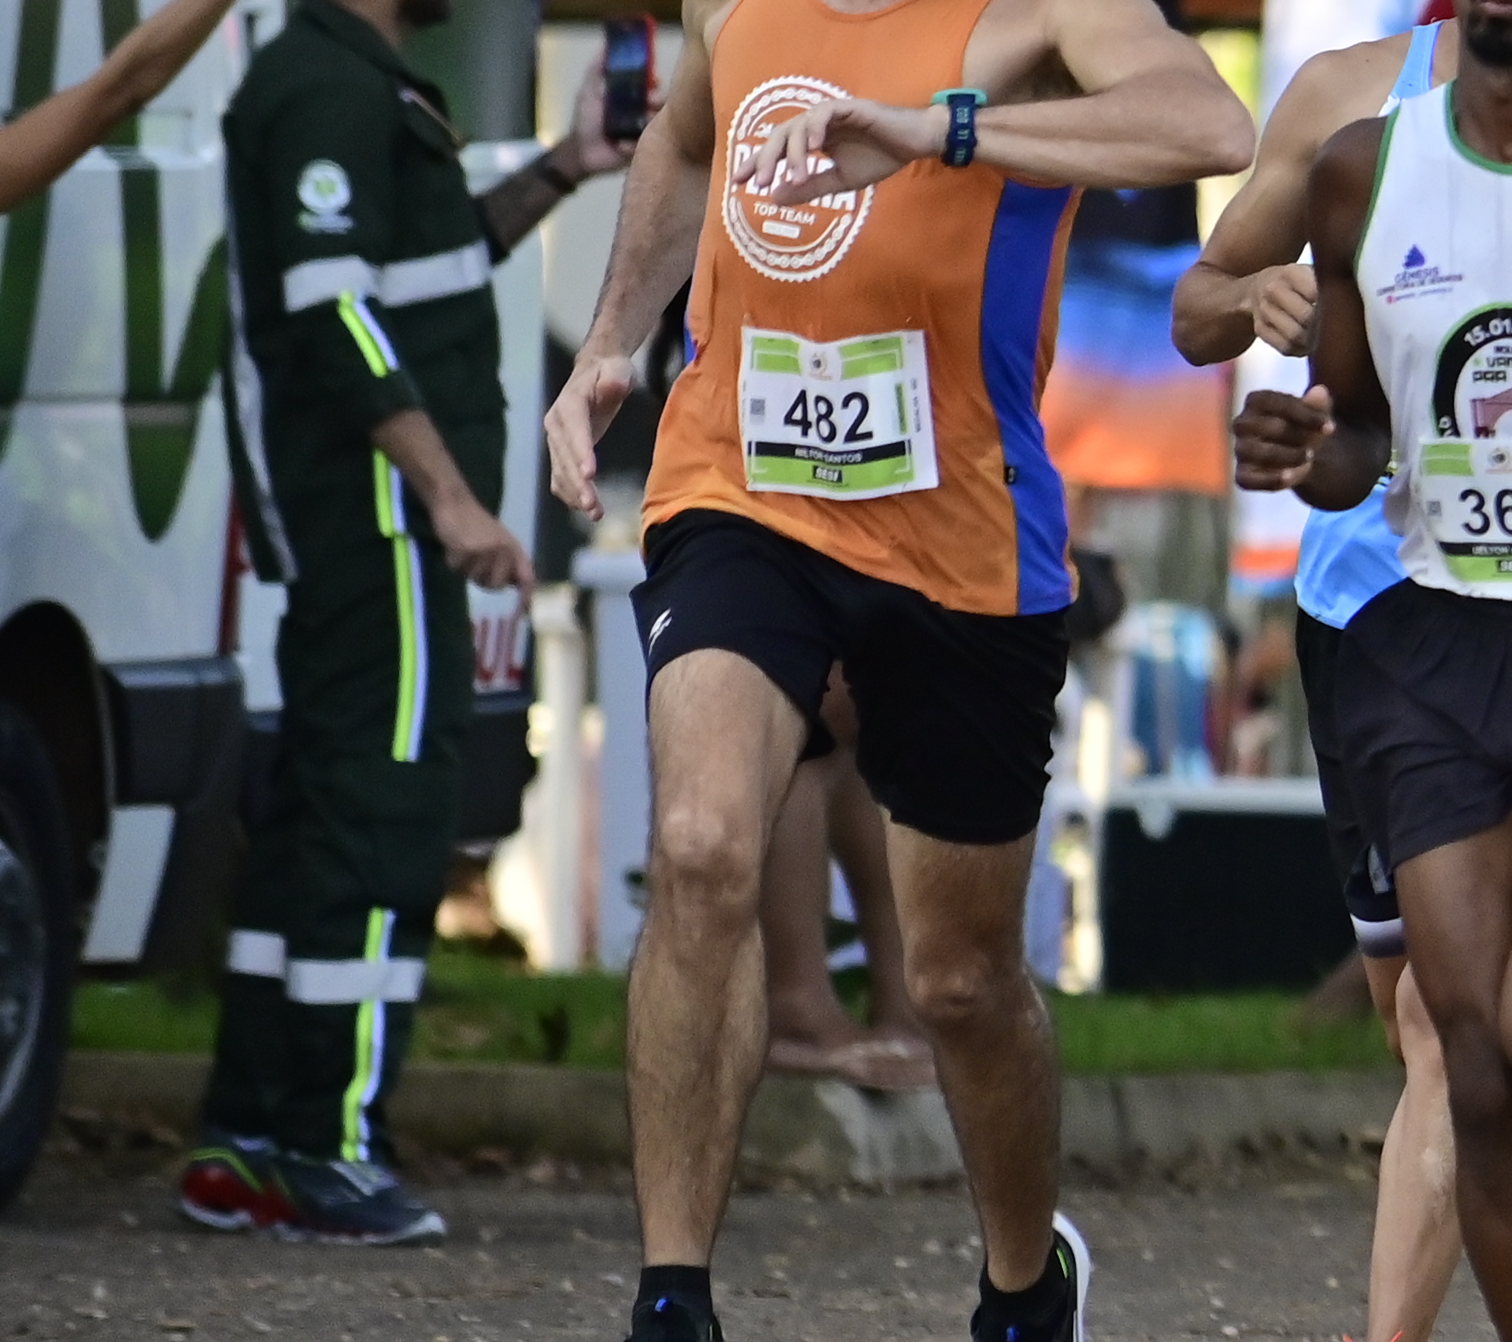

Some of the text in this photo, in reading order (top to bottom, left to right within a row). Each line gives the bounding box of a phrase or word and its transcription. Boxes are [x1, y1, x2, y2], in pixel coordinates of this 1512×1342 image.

[754, 202, 816, 225] TOP TEAM
[783, 388, 874, 444] 482
[815, 467, 839, 481] SESI
